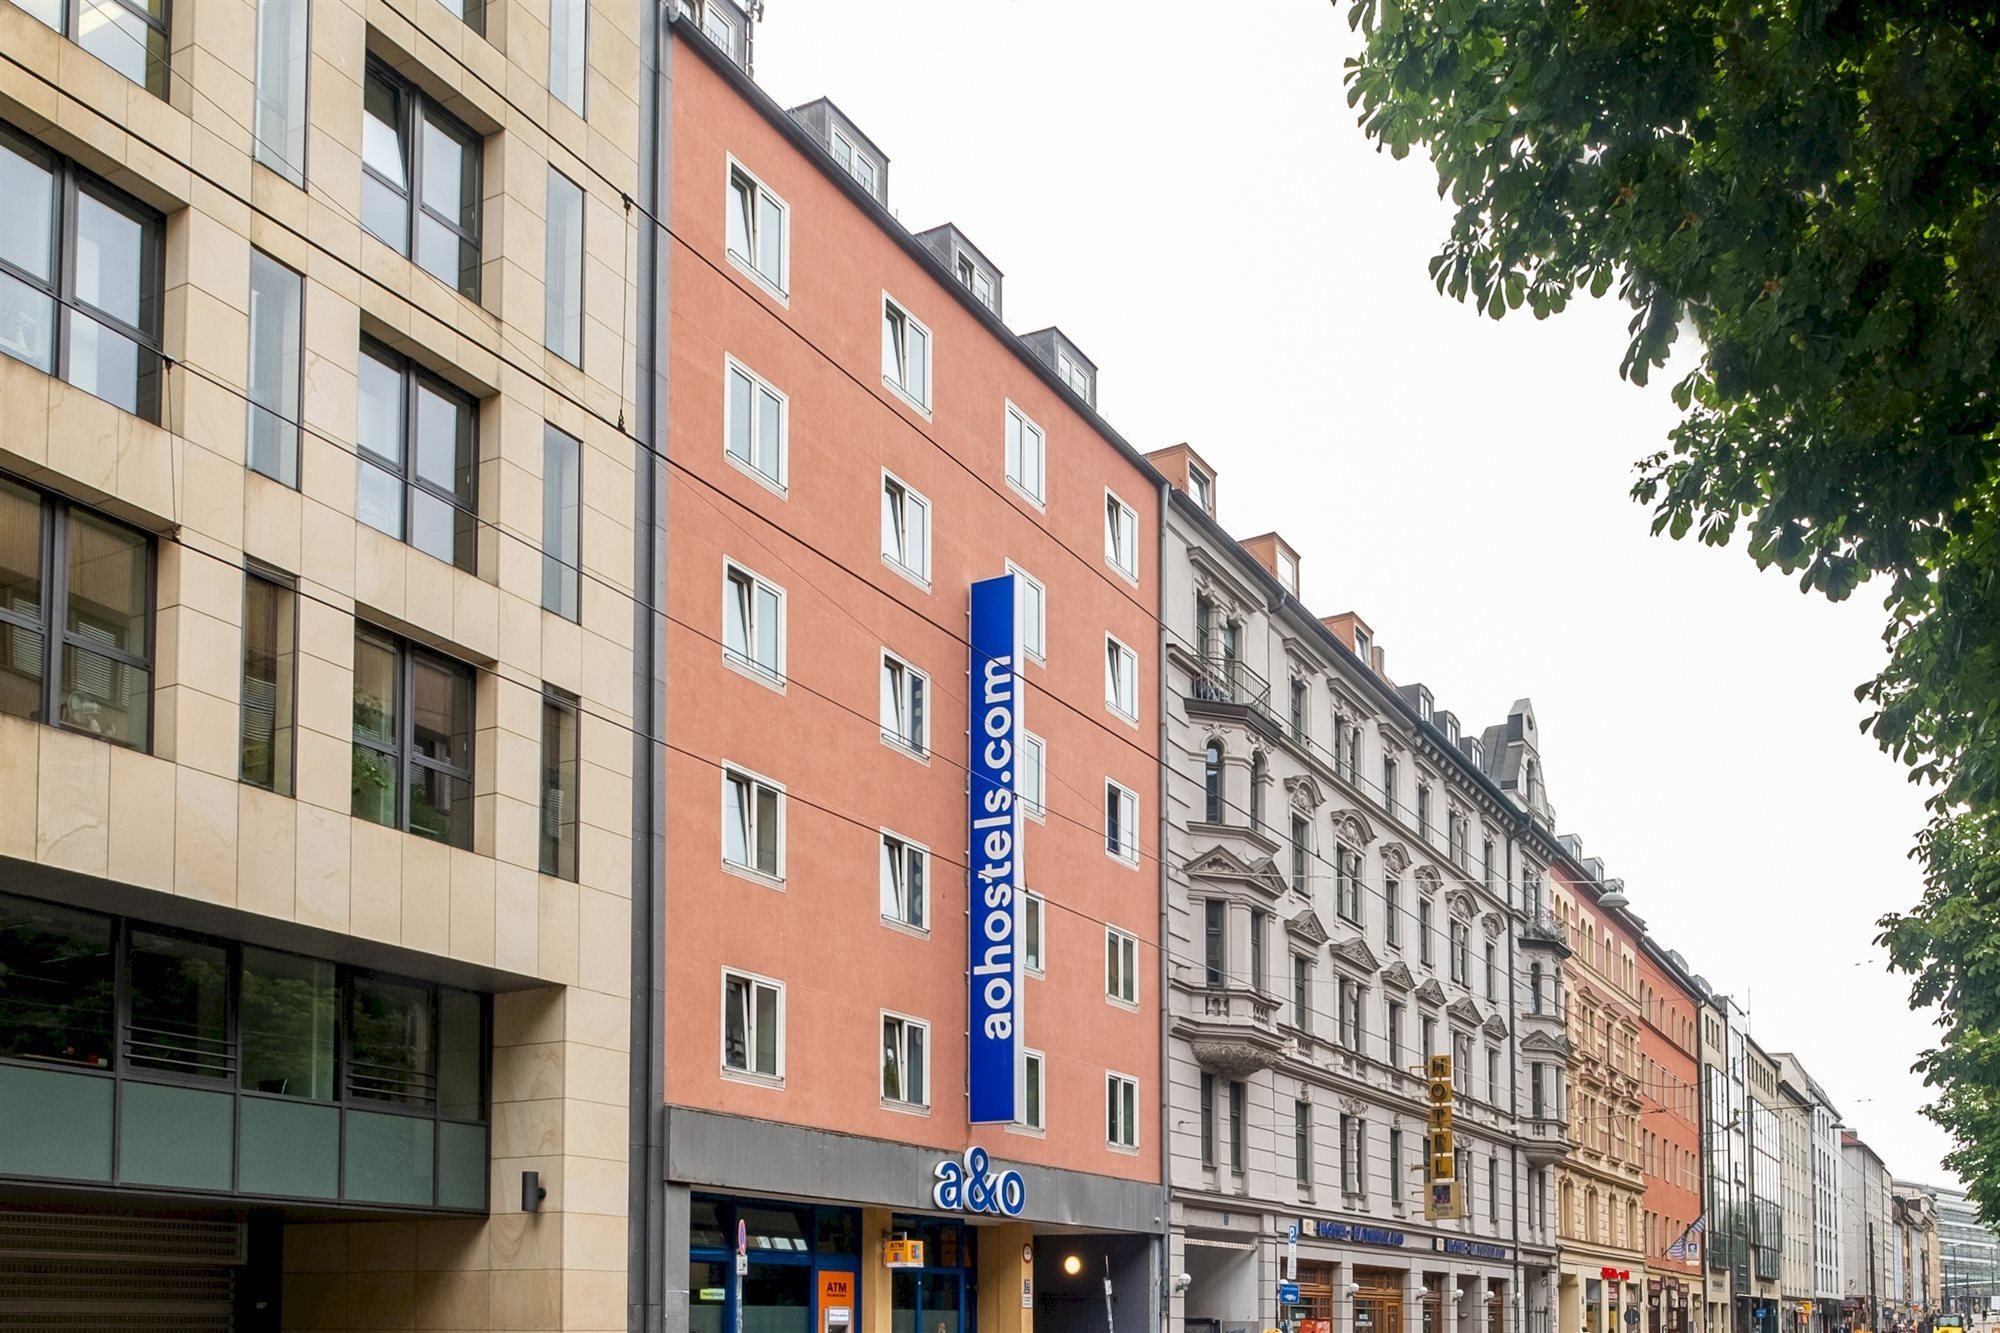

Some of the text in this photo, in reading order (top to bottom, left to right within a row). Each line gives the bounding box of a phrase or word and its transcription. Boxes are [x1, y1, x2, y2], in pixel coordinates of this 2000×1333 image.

[973, 655, 1011, 1041] aohostels.com
[1431, 1058, 1447, 1179] HOTEL
[933, 1146, 1026, 1217] a&o
[826, 1282, 847, 1293] ATM
